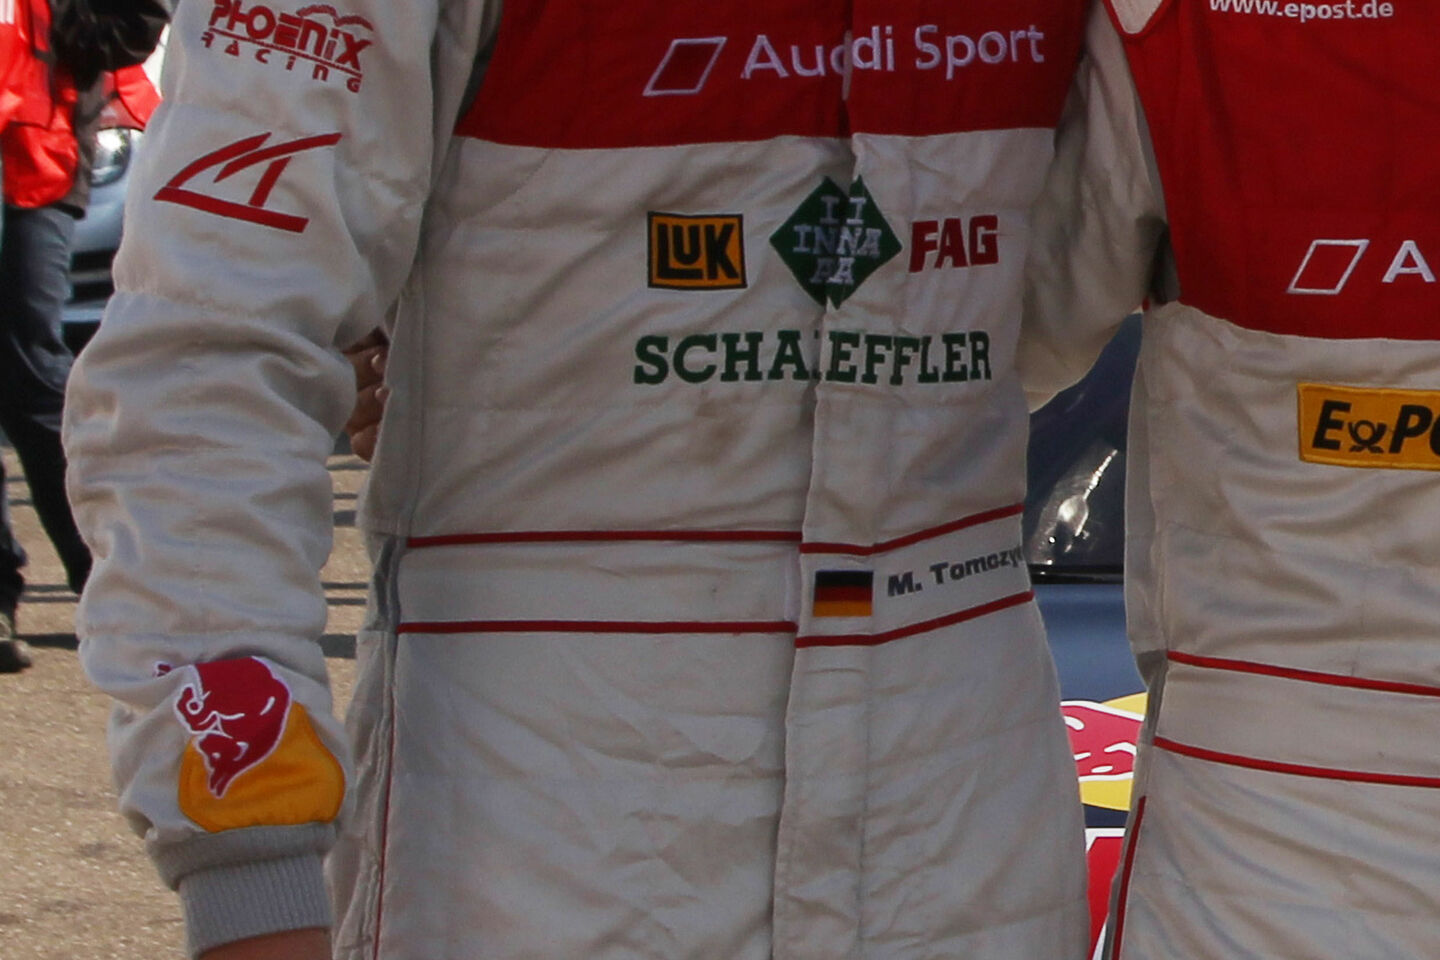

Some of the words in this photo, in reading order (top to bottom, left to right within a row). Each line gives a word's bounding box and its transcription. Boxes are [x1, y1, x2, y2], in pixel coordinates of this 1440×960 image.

[740, 25, 895, 79] Audi
[914, 25, 1045, 80] Sport
[909, 214, 999, 273] FAG
[634, 330, 993, 386] SCHAEFFLER
[888, 571, 923, 597] M.
[929, 544, 1021, 585] Tomczy
